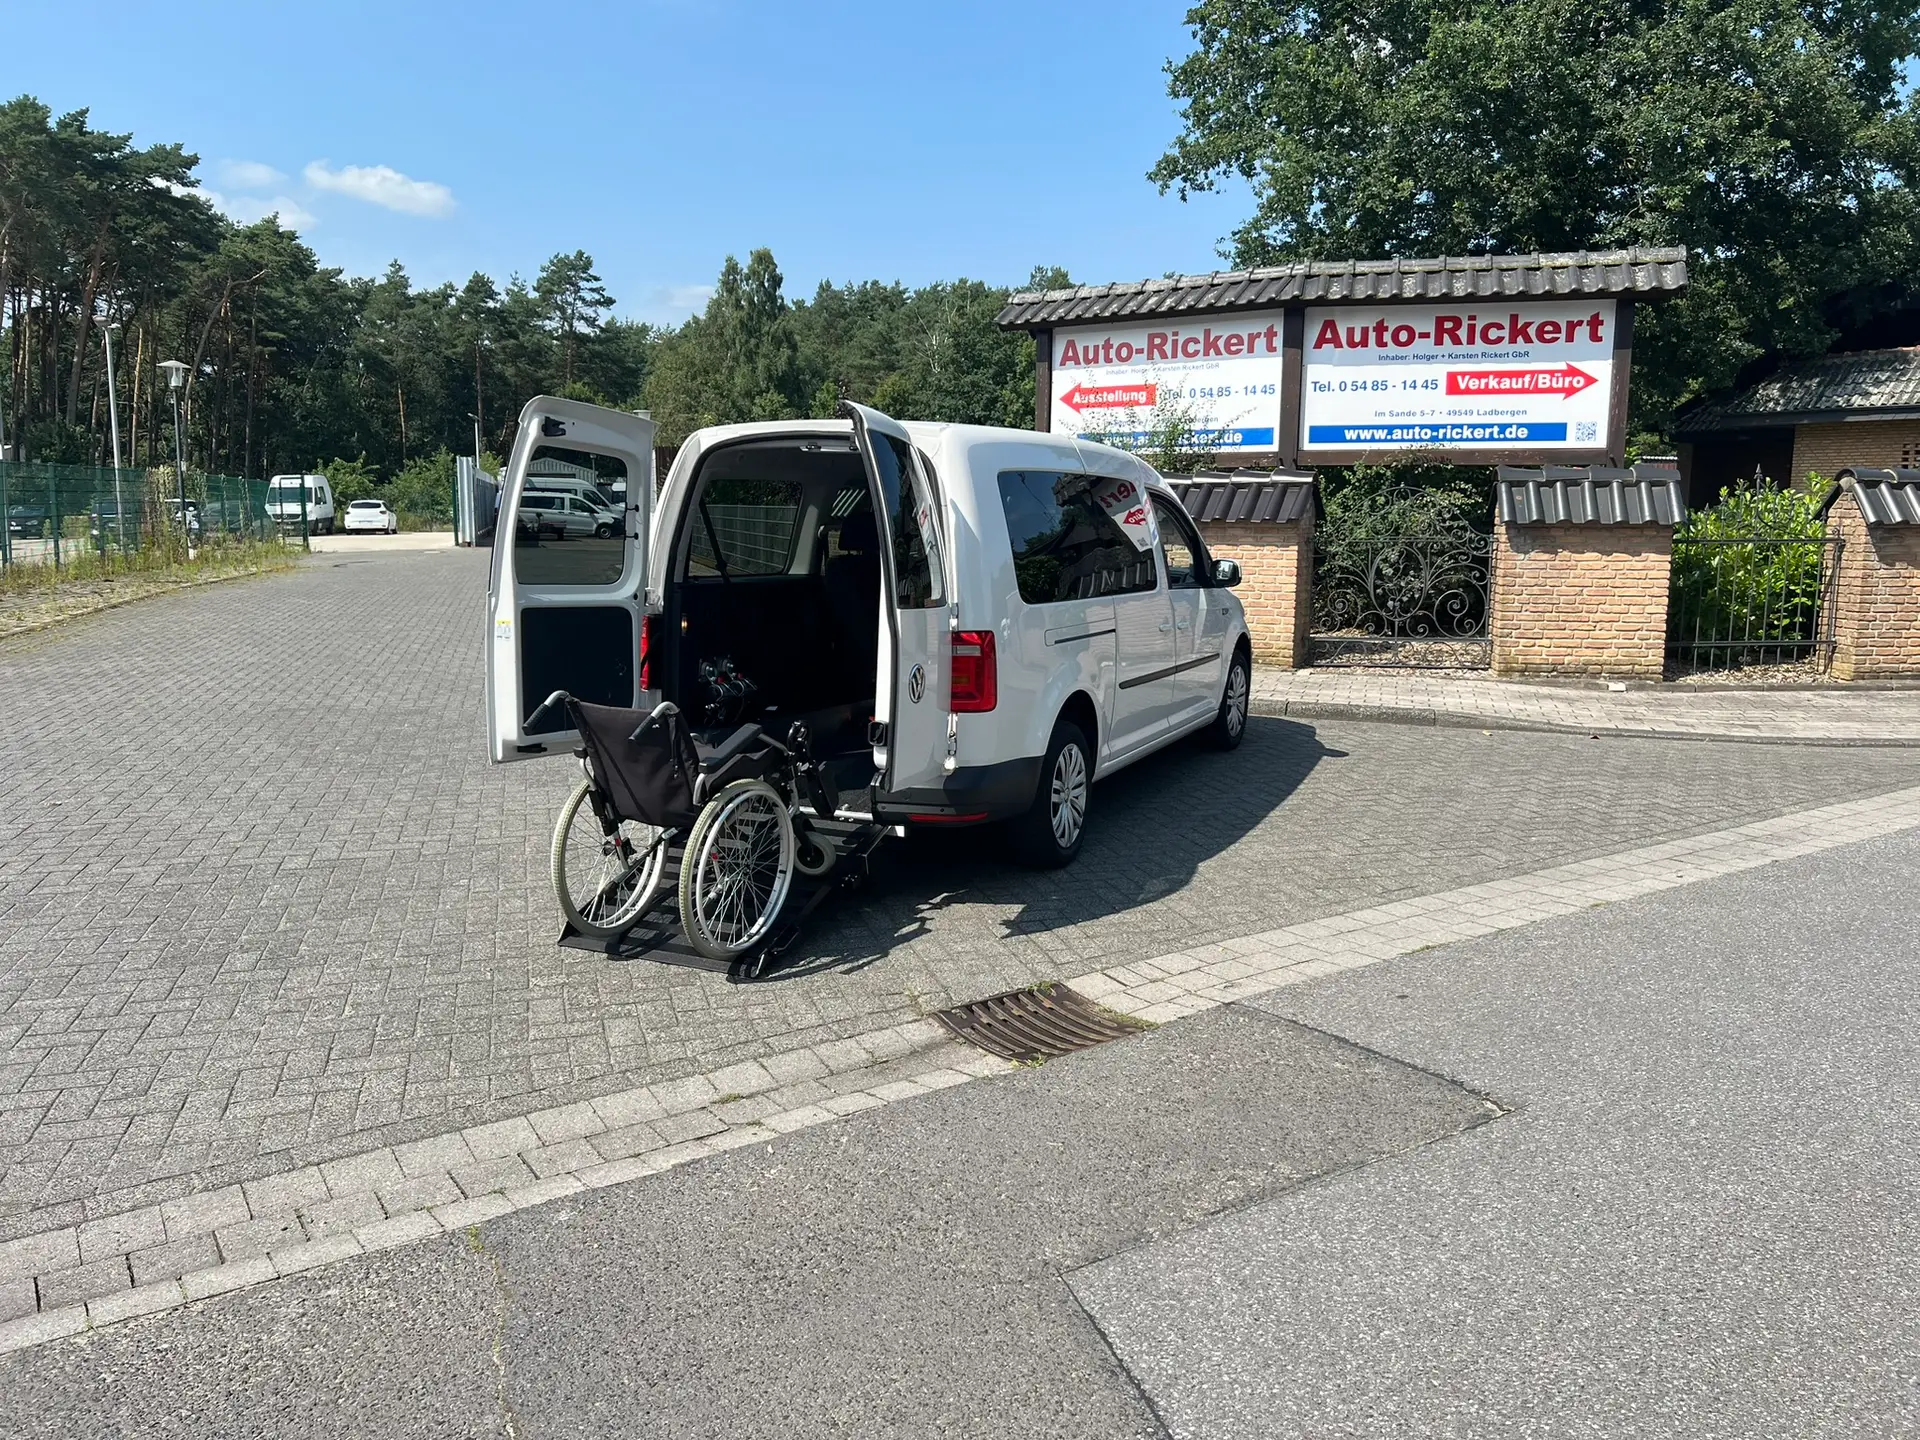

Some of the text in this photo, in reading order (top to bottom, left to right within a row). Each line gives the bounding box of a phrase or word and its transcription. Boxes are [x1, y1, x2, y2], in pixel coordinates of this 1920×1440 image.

[1313, 311, 1604, 350] Auto-Rickert
[1059, 323, 1278, 367] Auto-Rickert
[1412, 353, 1439, 361] Holger
[1511, 350, 1530, 358] GbR
[1311, 381, 1335, 392] Tel.
[1339, 380, 1347, 392] 0
[1350, 380, 1368, 391] 54
[1371, 380, 1389, 391] 85
[1401, 379, 1418, 390] 14
[1420, 379, 1439, 390] 45
[1456, 373, 1586, 390] Verkauf/Büro
[1072, 389, 1147, 404] Ausstellung
[1166, 388, 1186, 399] Tel.
[1189, 387, 1197, 399] 0
[1199, 387, 1215, 398] 54
[1216, 386, 1232, 397] 85
[1243, 384, 1258, 396] 14
[1260, 384, 1276, 395] 45
[1388, 409, 1417, 417] Sande
[1476, 408, 1528, 418] Ladbergen
[1343, 424, 1529, 440] www.auto-rickert.de
